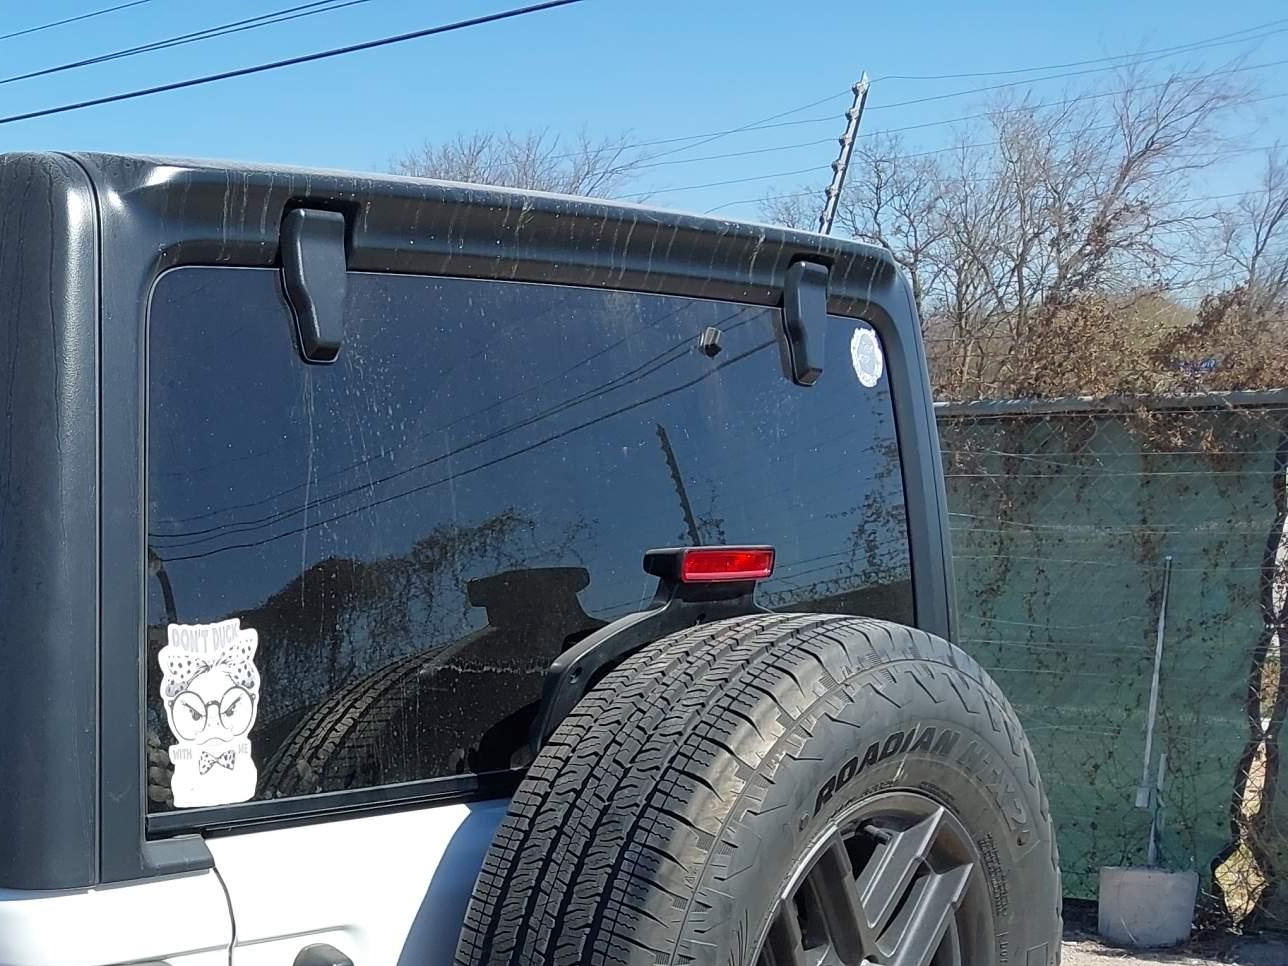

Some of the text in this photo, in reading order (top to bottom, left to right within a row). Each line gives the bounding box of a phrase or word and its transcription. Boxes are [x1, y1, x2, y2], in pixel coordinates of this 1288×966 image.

[172, 624, 239, 654] DON'T DUCK
[172, 742, 249, 761] WITH ME
[814, 727, 960, 817] ROADIAN
